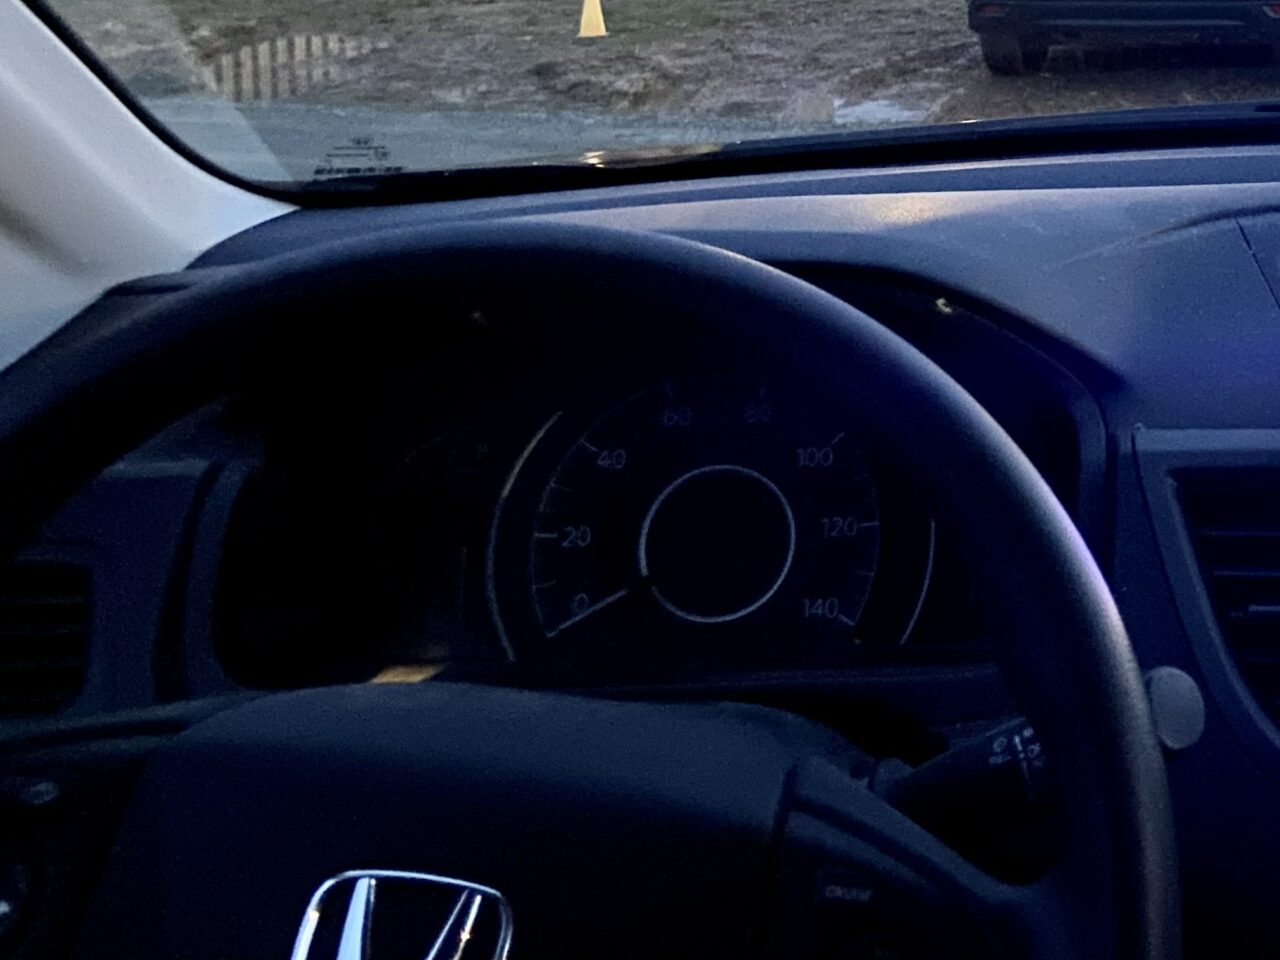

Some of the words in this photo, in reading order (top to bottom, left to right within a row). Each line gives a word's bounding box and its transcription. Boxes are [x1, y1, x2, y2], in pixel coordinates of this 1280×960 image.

[597, 449, 627, 469] 40
[797, 447, 833, 467] 100
[561, 526, 591, 548] 20
[821, 518, 858, 538] 120
[803, 597, 839, 618] 140
